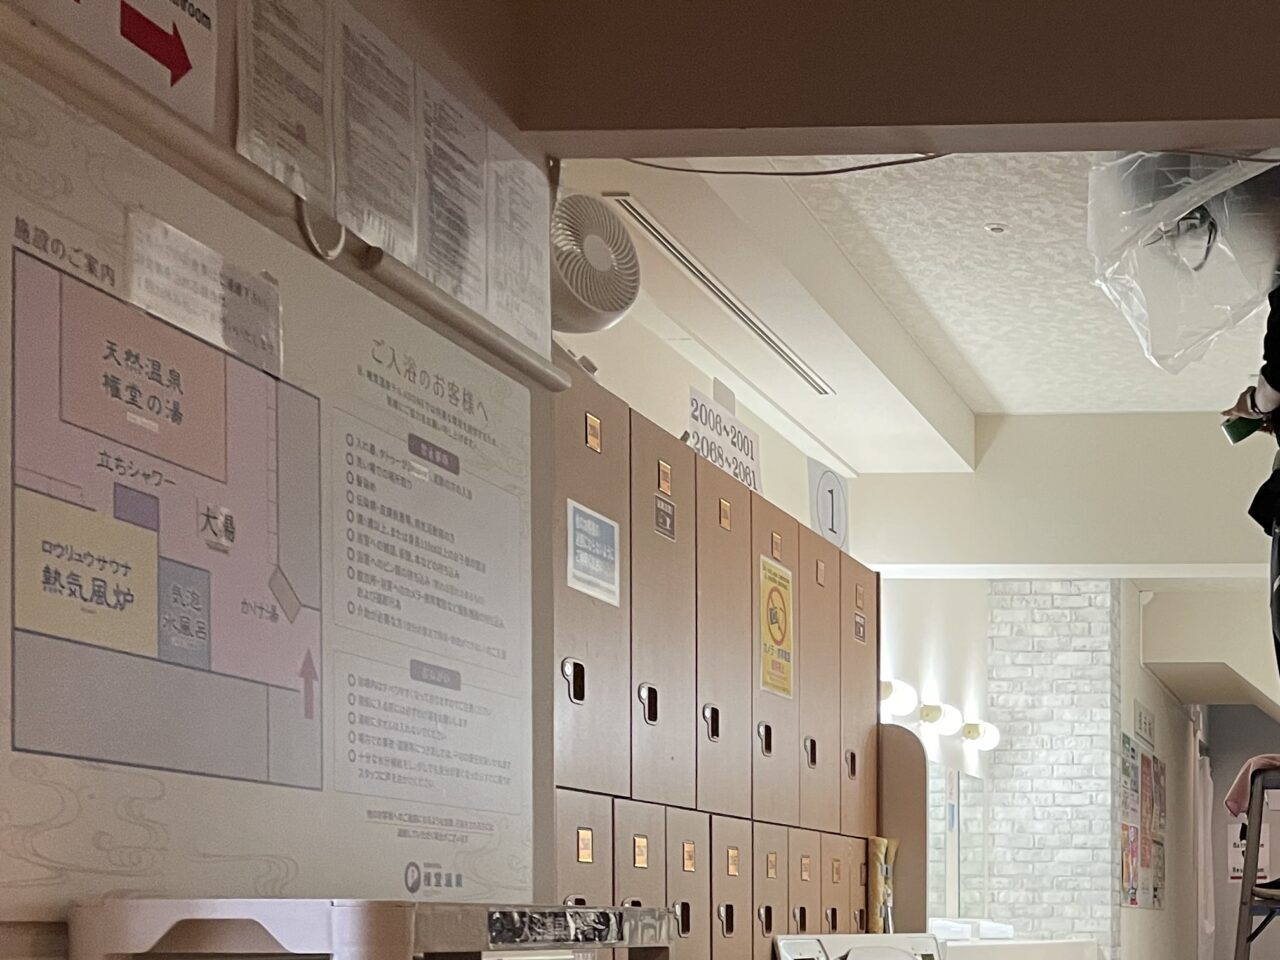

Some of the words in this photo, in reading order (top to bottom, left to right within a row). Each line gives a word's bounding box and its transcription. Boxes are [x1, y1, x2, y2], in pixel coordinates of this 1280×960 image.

[103, 339, 184, 396] 天然温泉
[370, 338, 489, 422] ご入浴のお客様へ
[102, 371, 184, 426] 権堂の湯
[96, 449, 177, 487] 立ちシャワー
[42, 565, 135, 612] 熱気風炉
